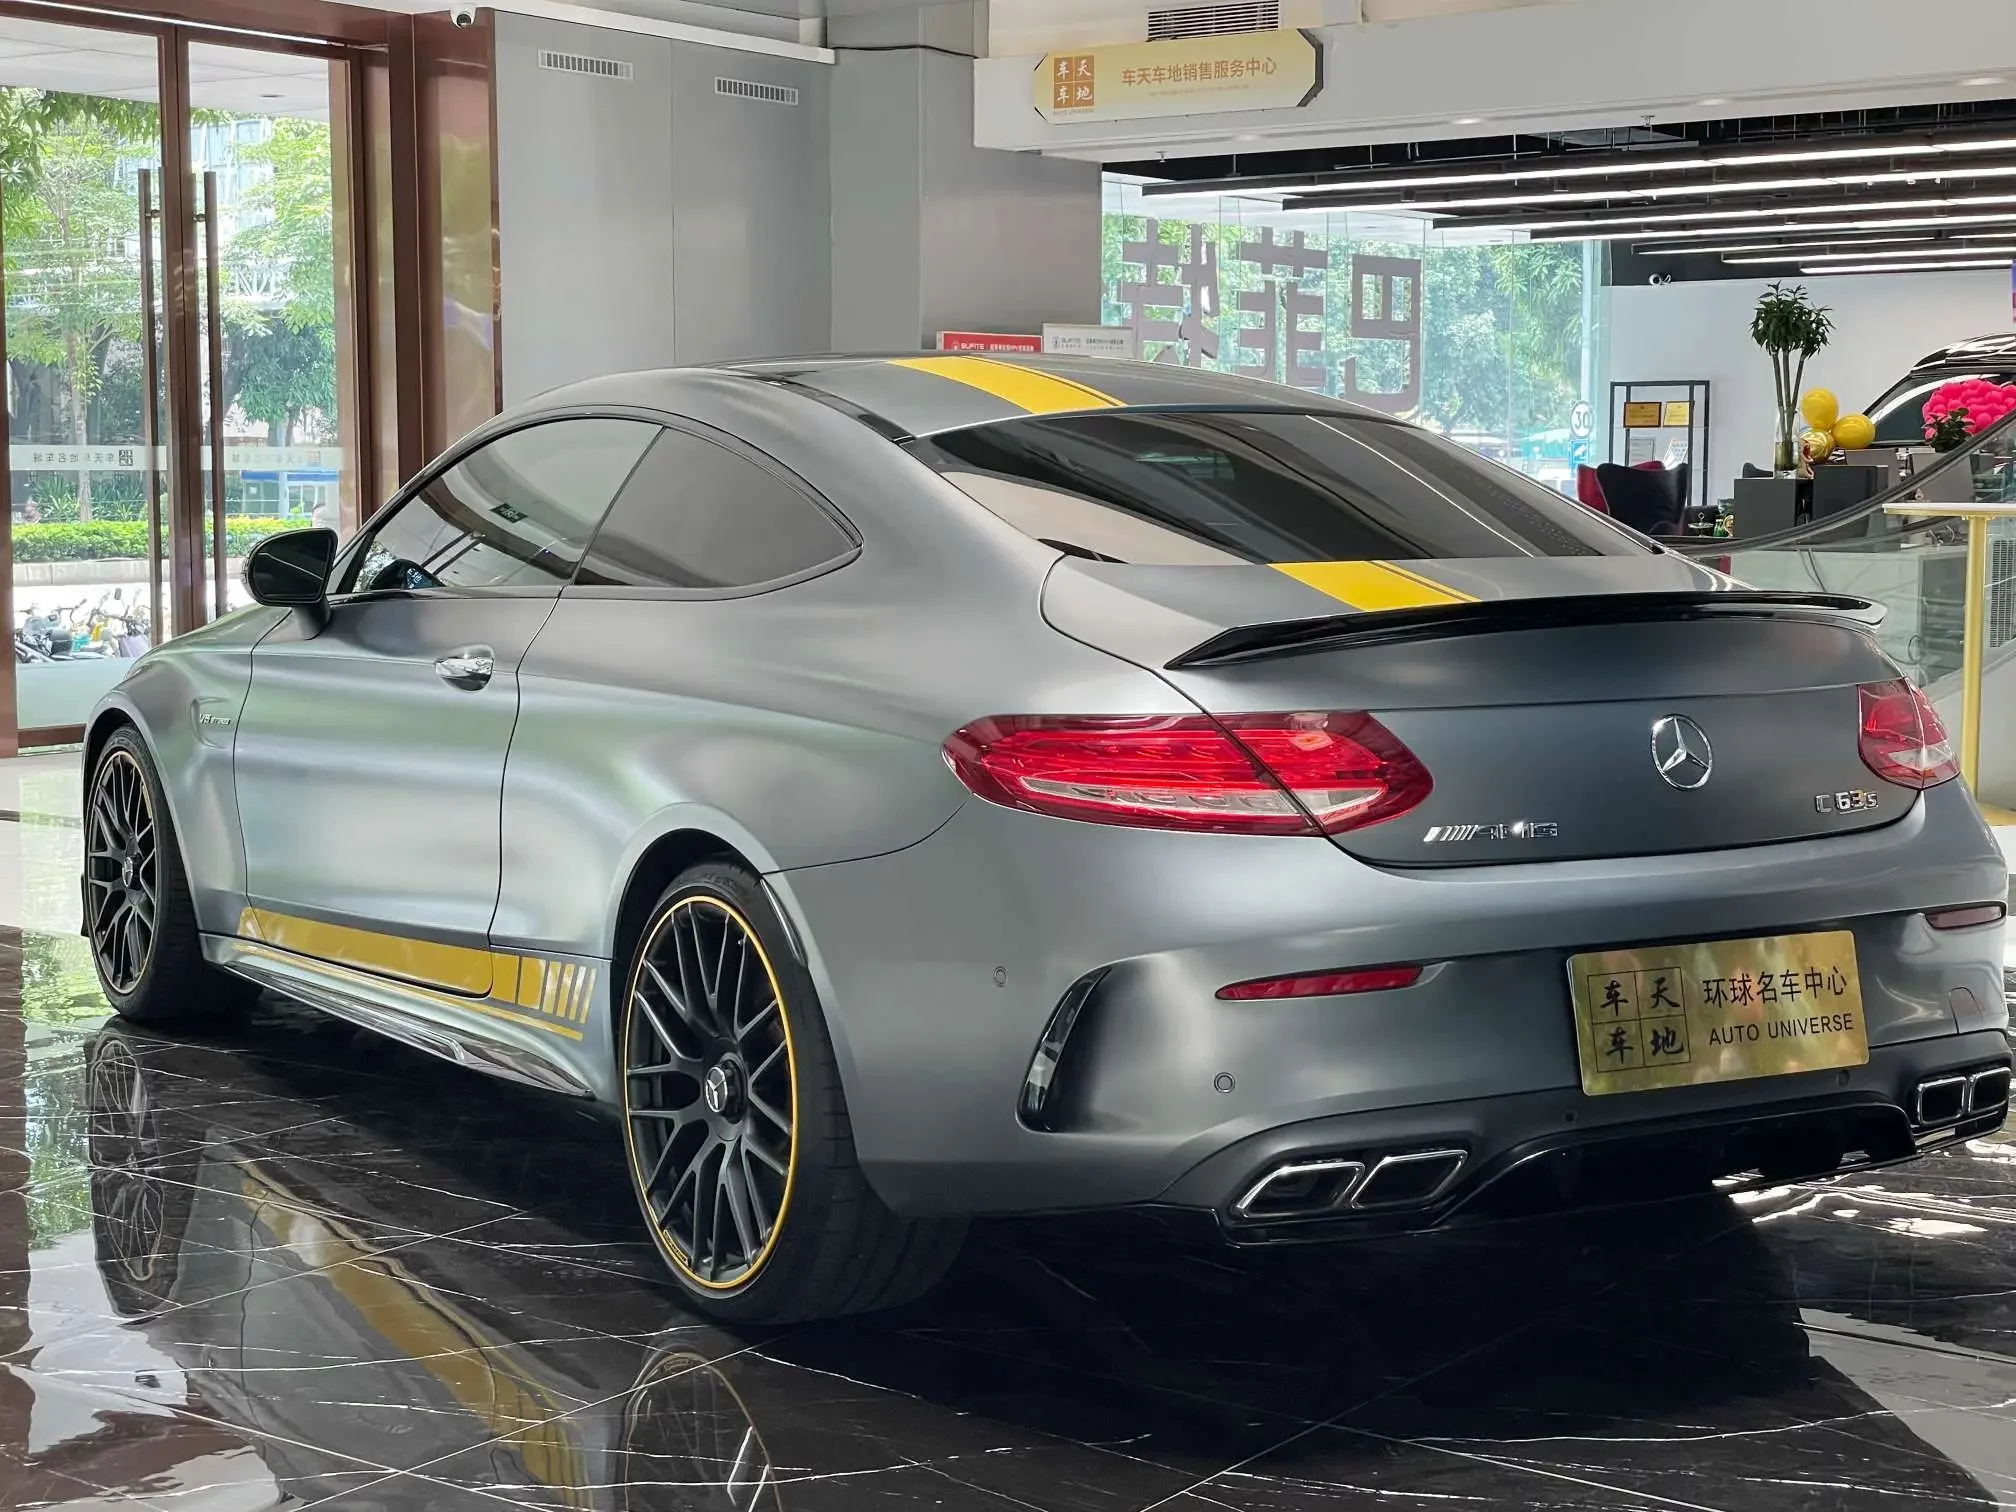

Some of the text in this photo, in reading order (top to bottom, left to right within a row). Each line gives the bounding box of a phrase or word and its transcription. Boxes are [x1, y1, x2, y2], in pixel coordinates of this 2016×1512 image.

[1122, 57, 1278, 87] 车天车地销售服务中心
[1575, 411, 1589, 430] 30
[1702, 965, 1847, 1009] 环球名车中心
[1709, 1013, 1854, 1046] AUTO UNIVERSE
